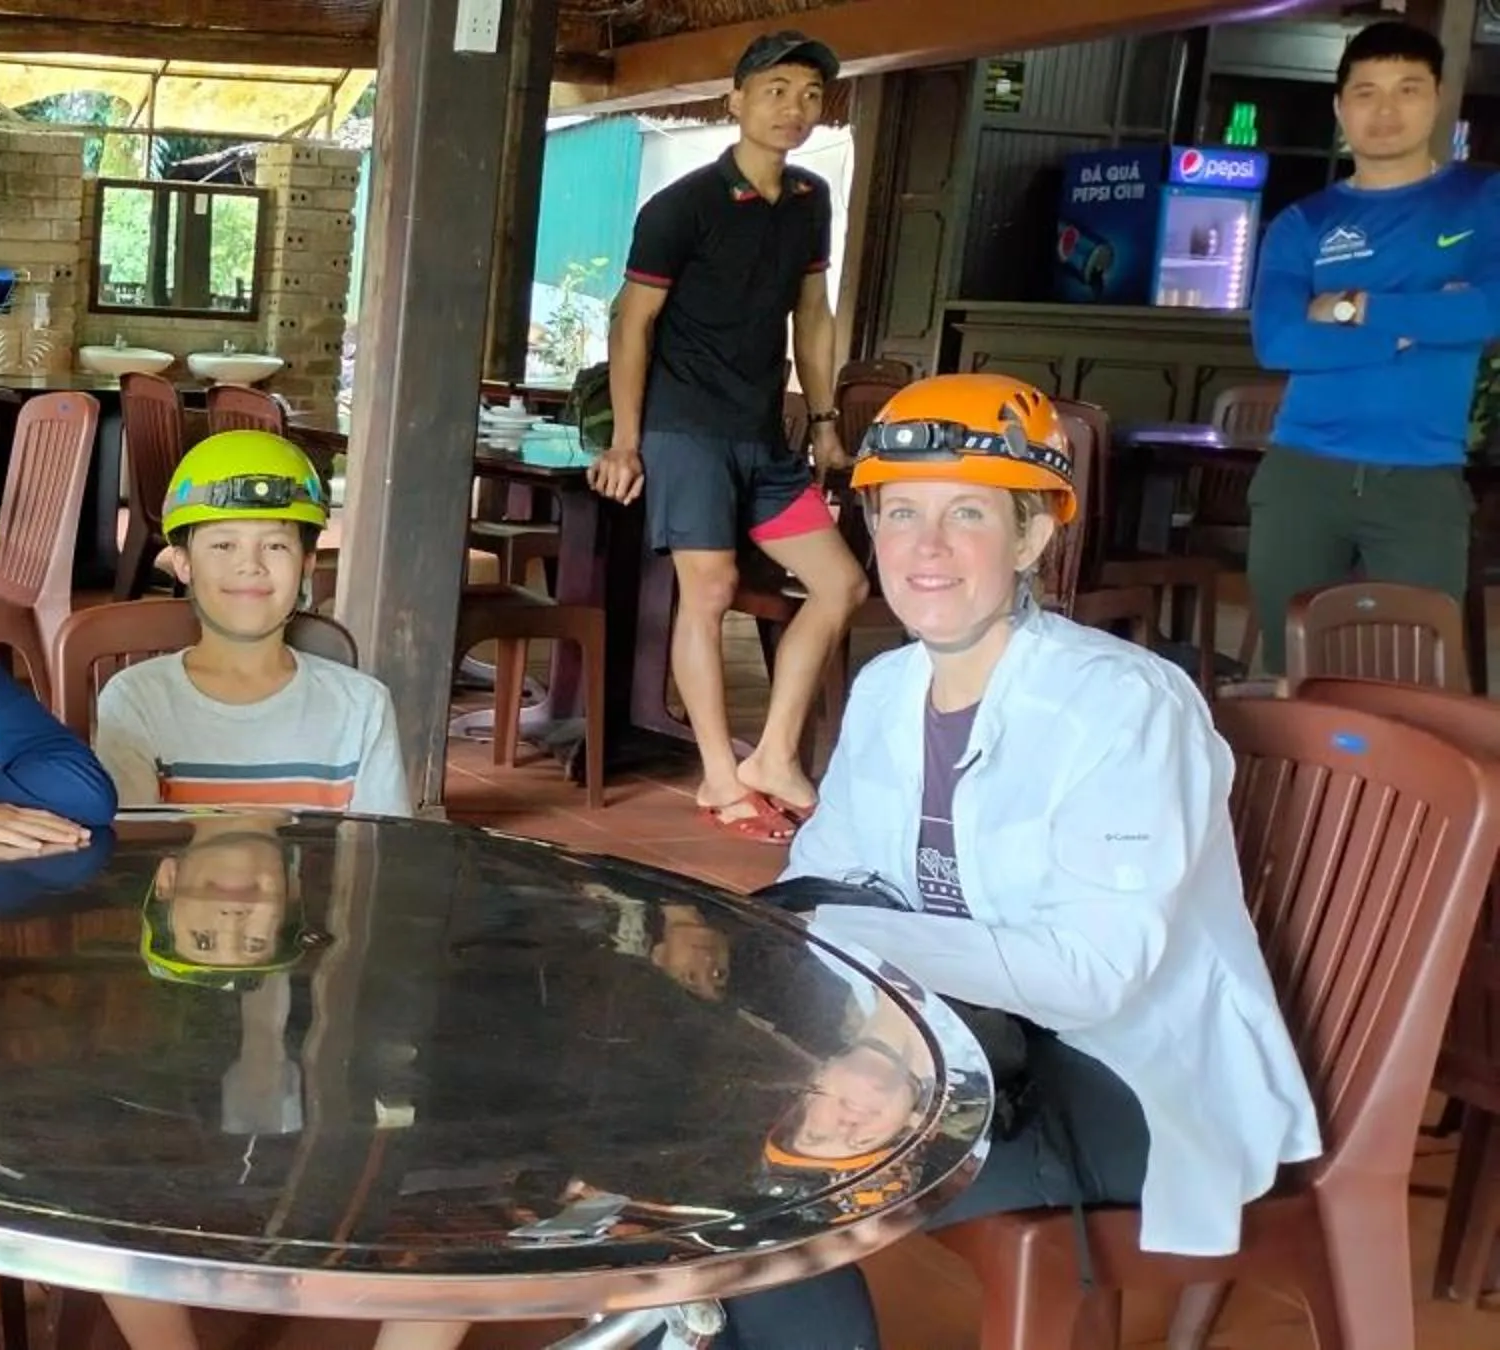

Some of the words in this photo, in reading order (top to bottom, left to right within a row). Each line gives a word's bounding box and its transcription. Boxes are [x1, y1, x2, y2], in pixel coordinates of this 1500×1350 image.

[1106, 160, 1141, 182] QUÁ
[1204, 158, 1255, 182] pepsi
[1072, 186, 1112, 203] PEPSI
